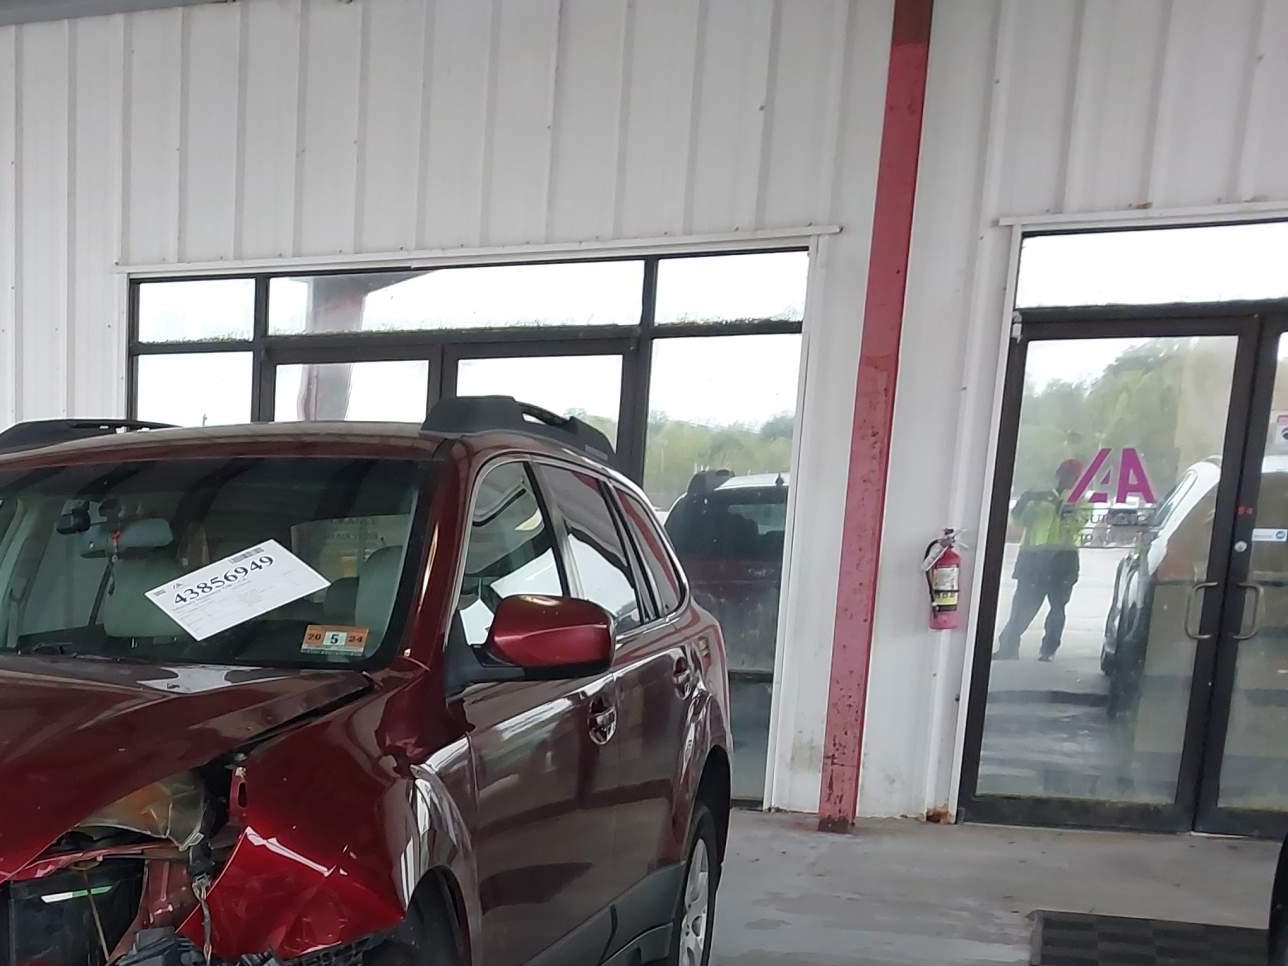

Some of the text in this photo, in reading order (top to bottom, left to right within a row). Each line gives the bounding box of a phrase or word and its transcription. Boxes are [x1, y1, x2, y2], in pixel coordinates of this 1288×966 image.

[173, 555, 274, 606] 43856949
[307, 632, 363, 645] 20 5 24
